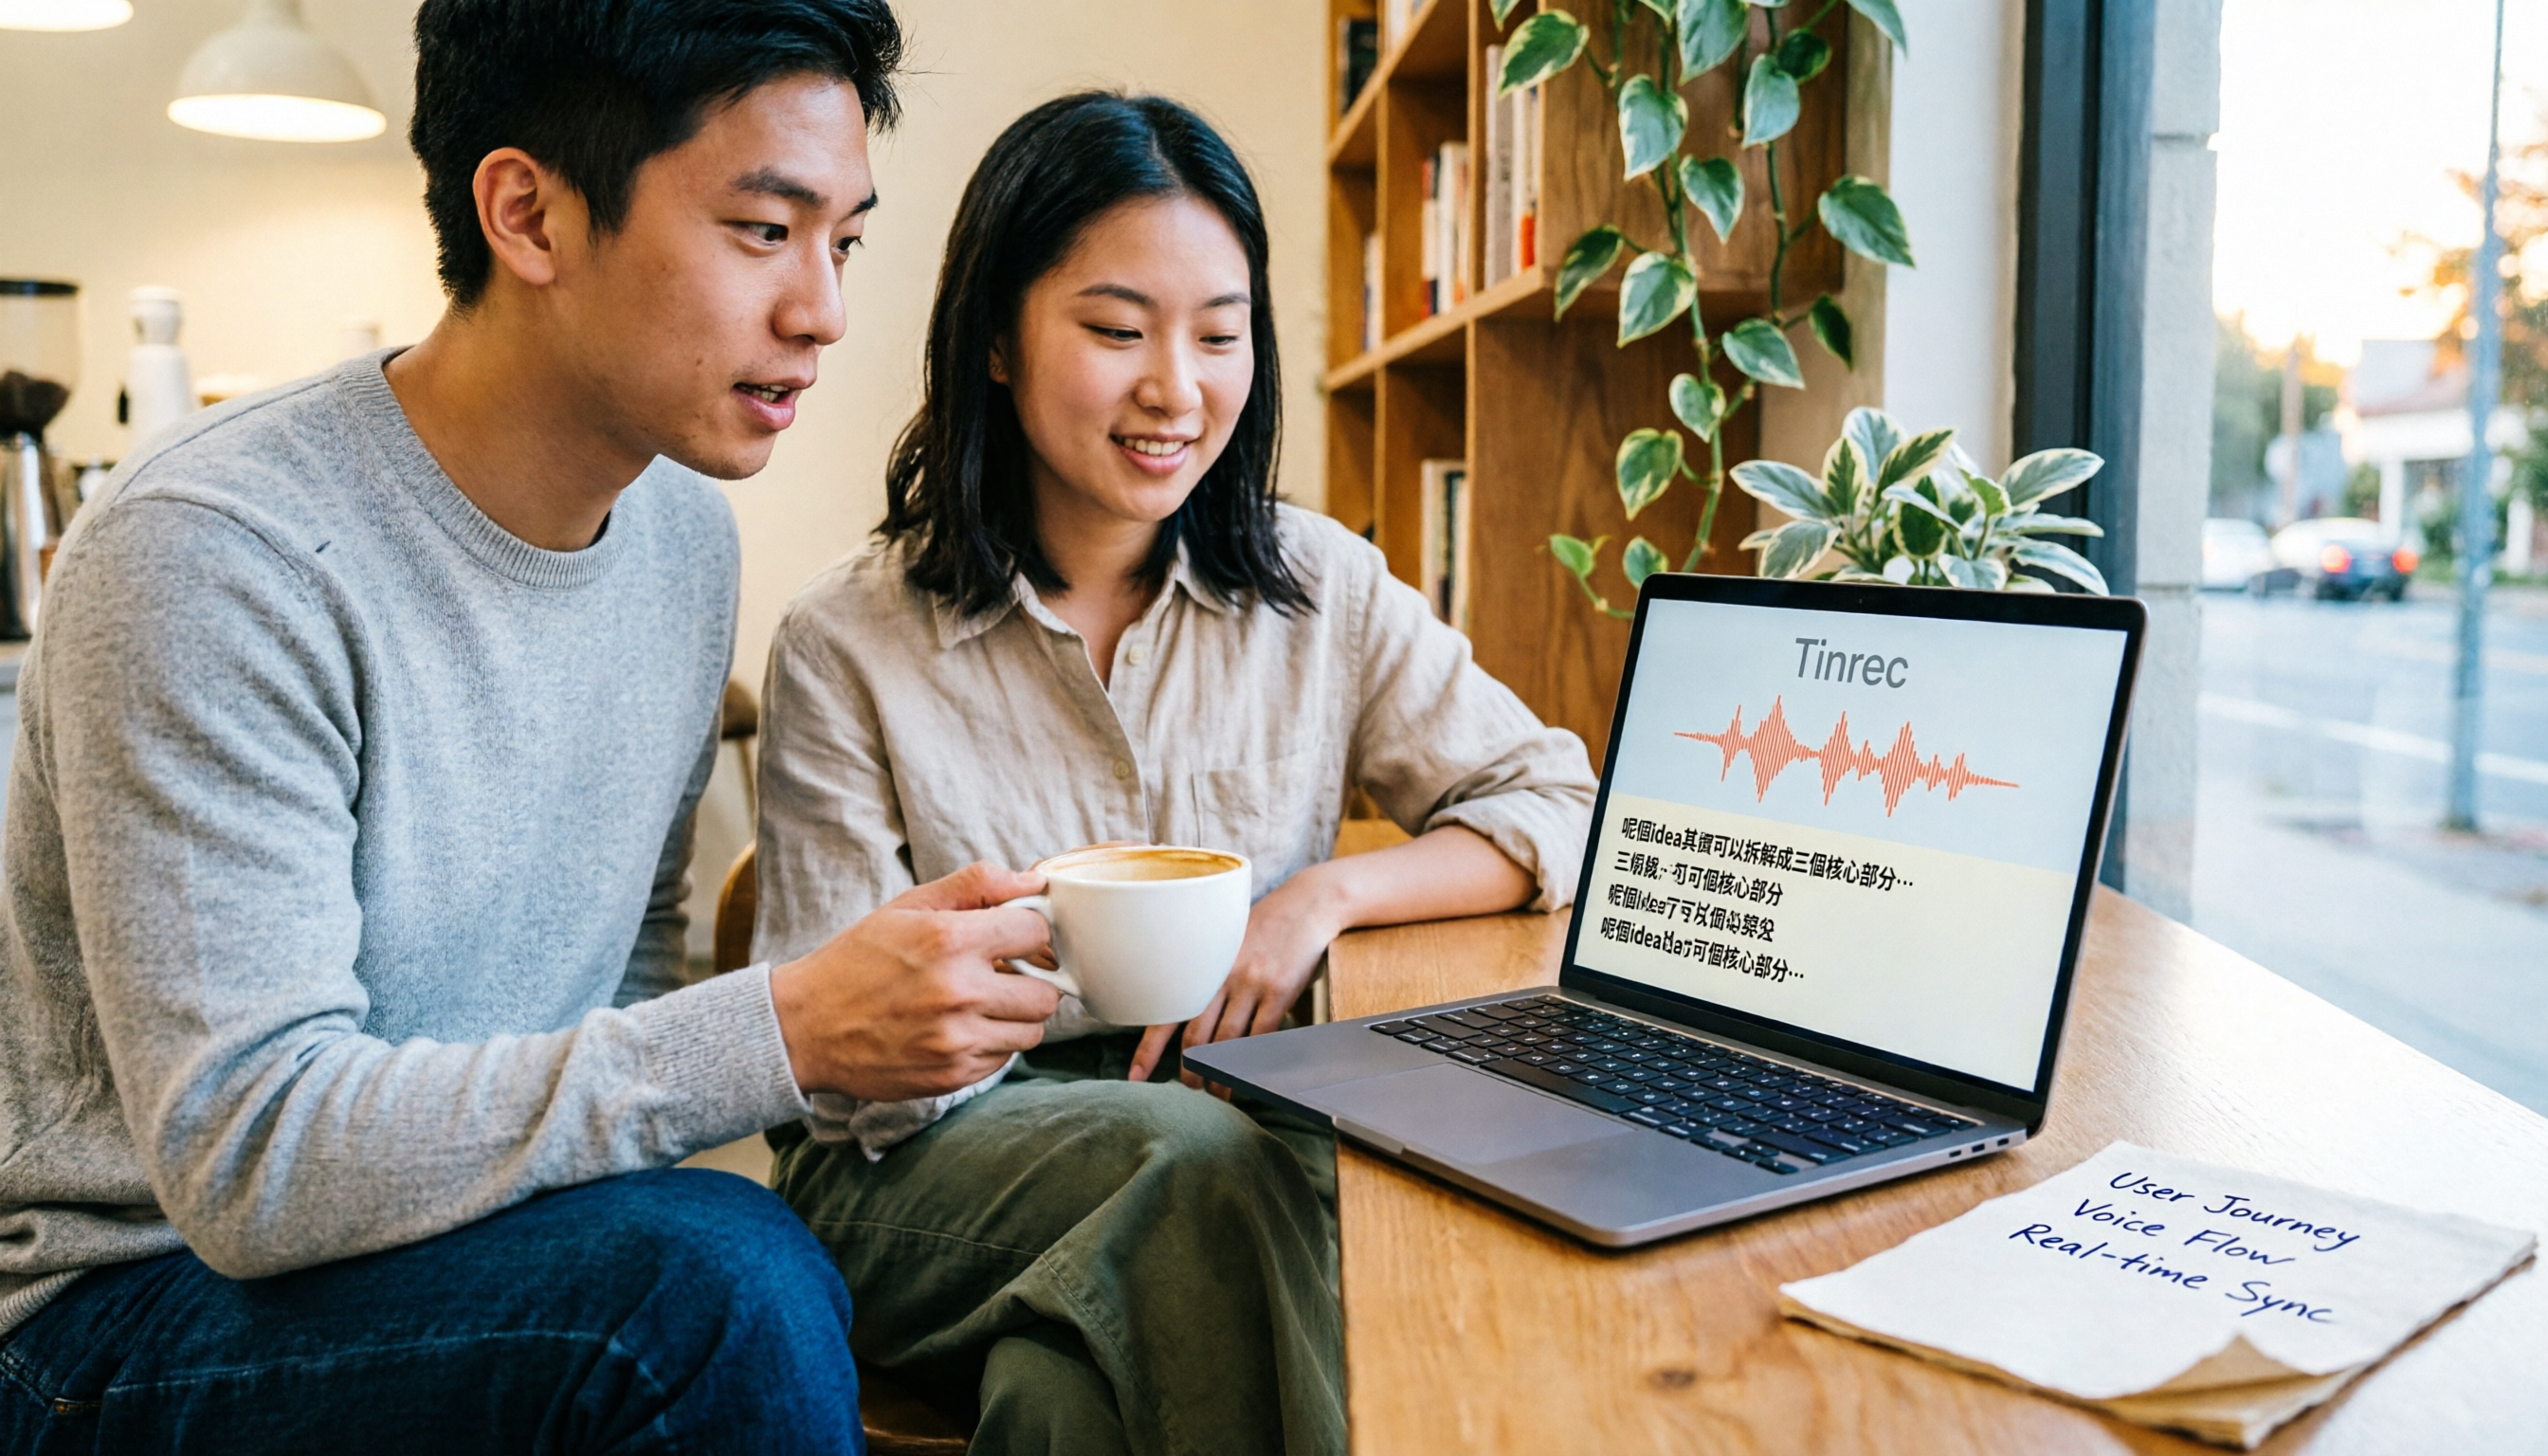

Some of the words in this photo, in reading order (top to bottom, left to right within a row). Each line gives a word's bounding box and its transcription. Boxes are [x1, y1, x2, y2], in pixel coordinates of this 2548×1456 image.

[1795, 637, 1909, 689] Tinrec
[2073, 1198, 2167, 1237] Voice
[2183, 1228, 2296, 1266] Flow
[2109, 1172, 2195, 1203] User
[2203, 1194, 2361, 1253] Journey
[2009, 1223, 2209, 1290] Real-time
[2225, 1281, 2337, 1325] Sync
